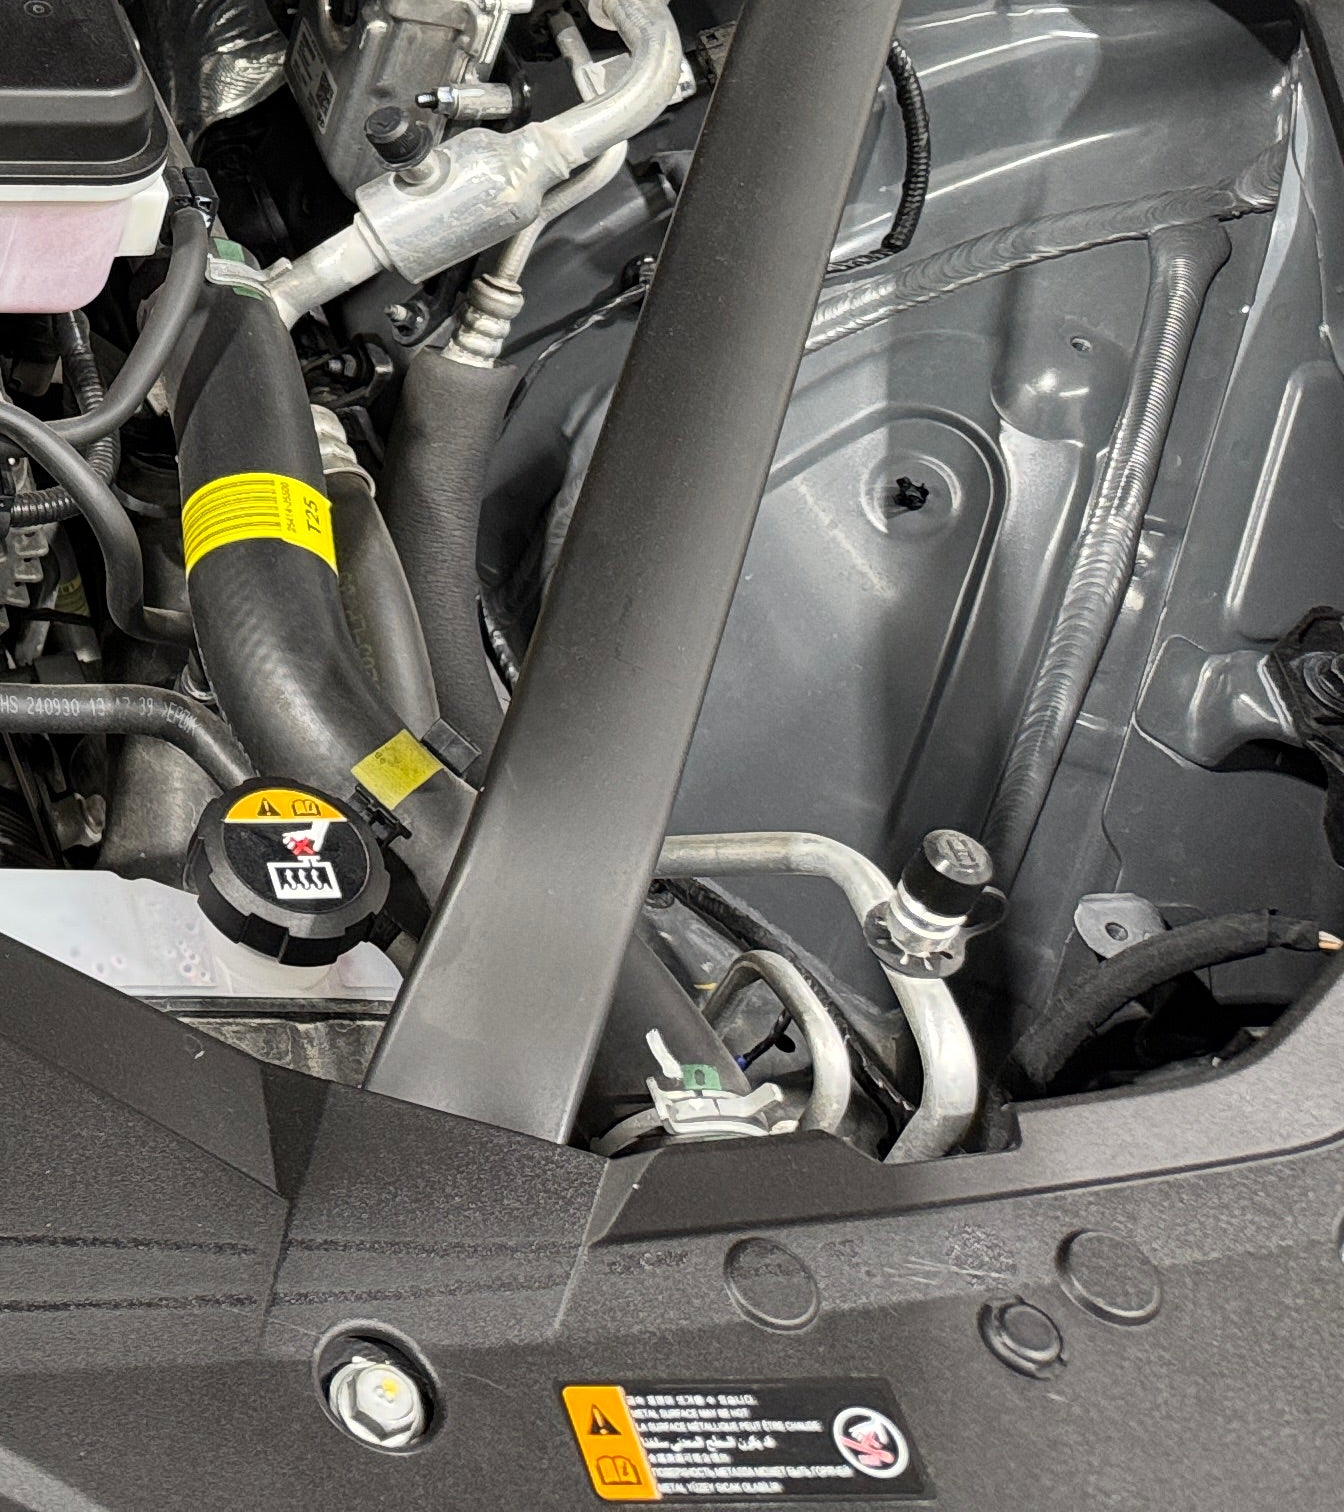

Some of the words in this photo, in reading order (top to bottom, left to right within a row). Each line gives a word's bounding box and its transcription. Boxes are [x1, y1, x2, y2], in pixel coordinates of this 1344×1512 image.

[303, 496, 322, 534] T25
[0, 694, 19, 715] HS
[26, 696, 80, 717] 240930
